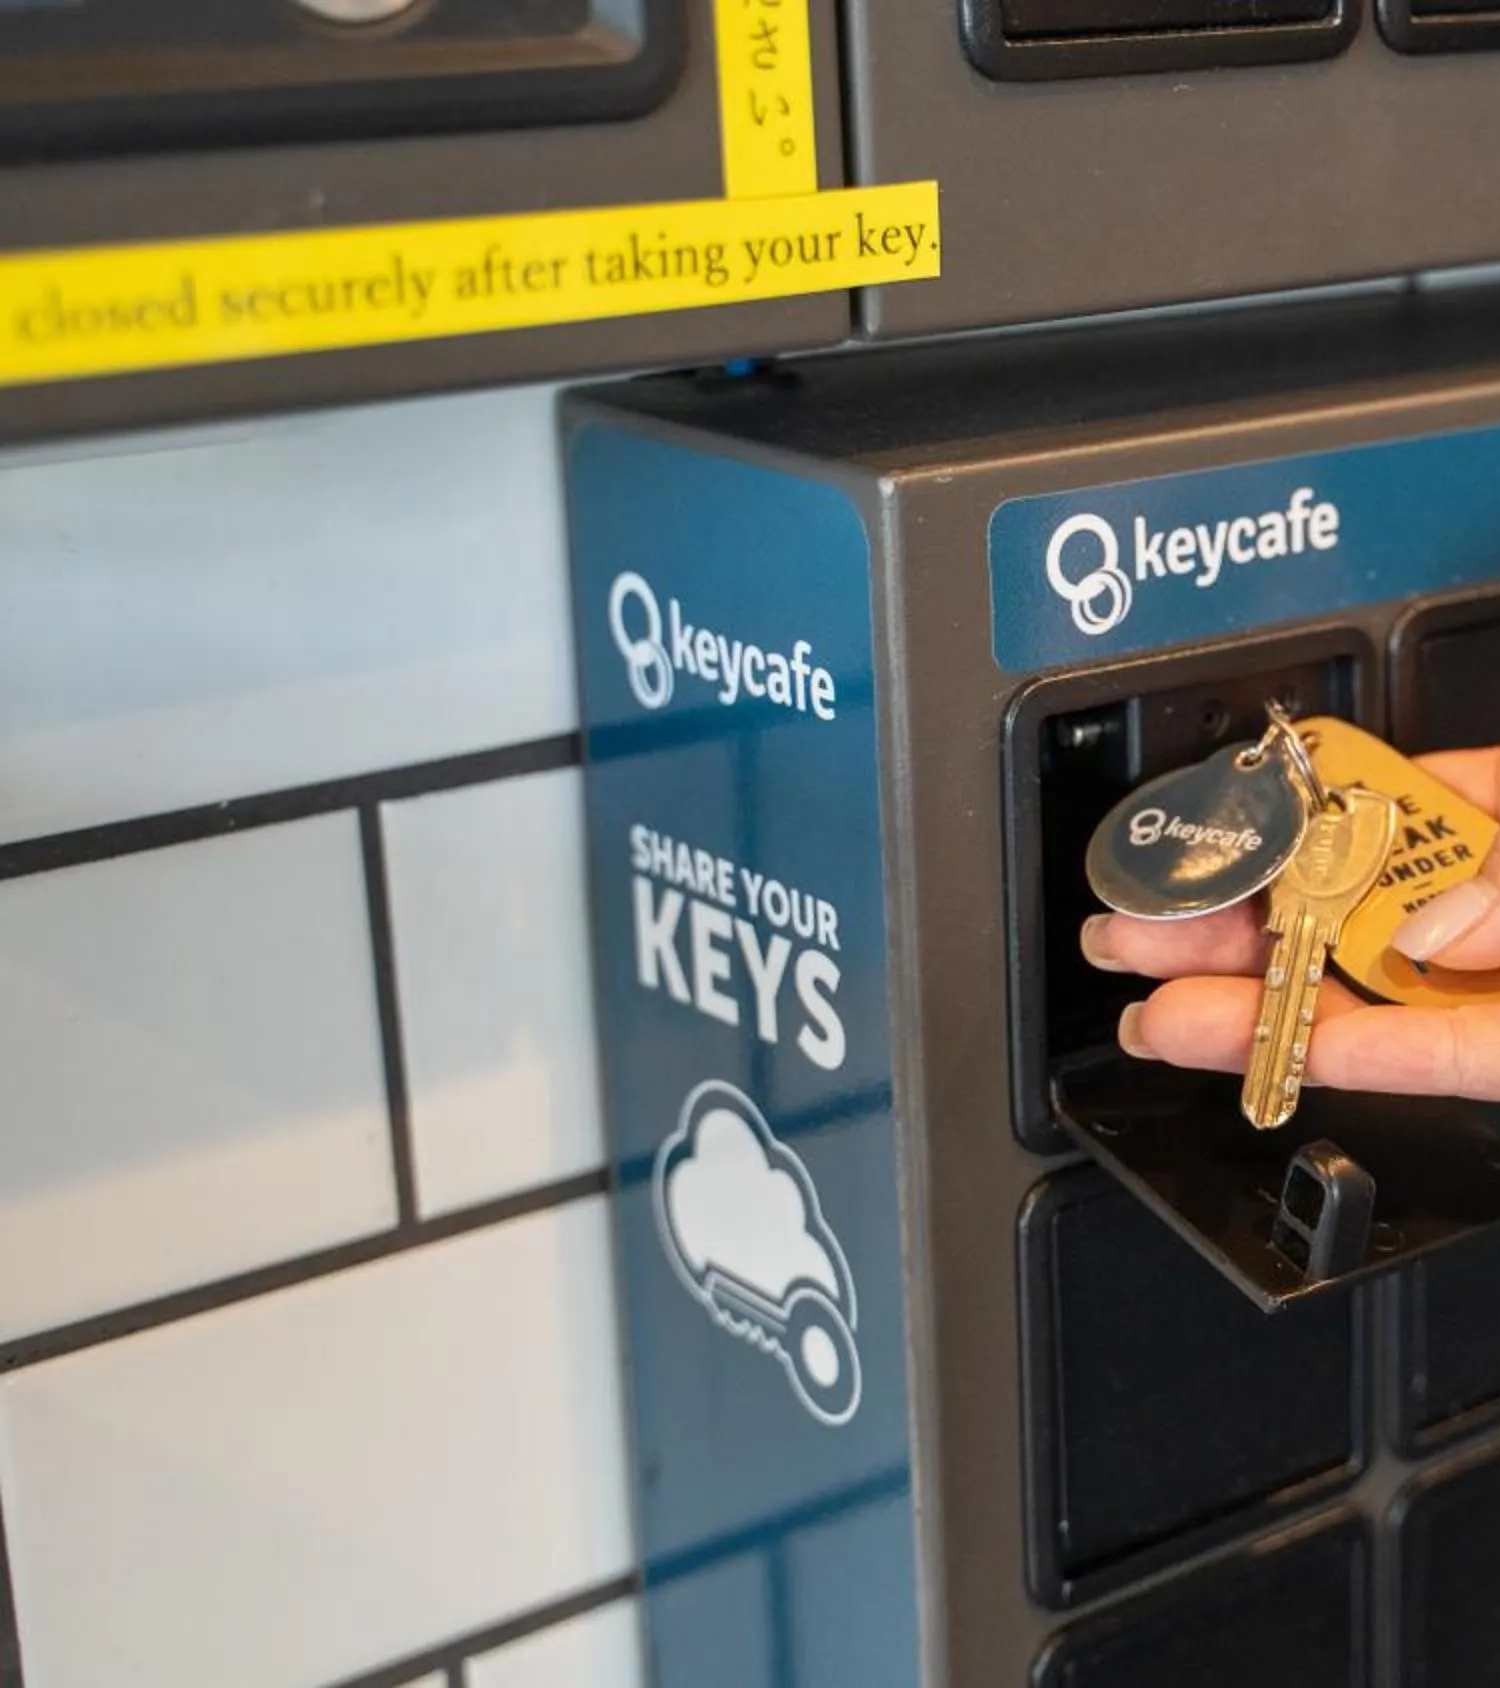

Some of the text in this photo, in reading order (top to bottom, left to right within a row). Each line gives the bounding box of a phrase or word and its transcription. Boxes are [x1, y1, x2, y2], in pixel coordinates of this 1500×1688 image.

[15, 213, 939, 343] closed securely after taking your key.
[1133, 486, 1341, 588] keycafe
[669, 597, 836, 721] keycafe
[629, 823, 842, 951] SHARE YOUR
[1163, 815, 1263, 851] keycafe
[632, 873, 847, 1071] KEYS
